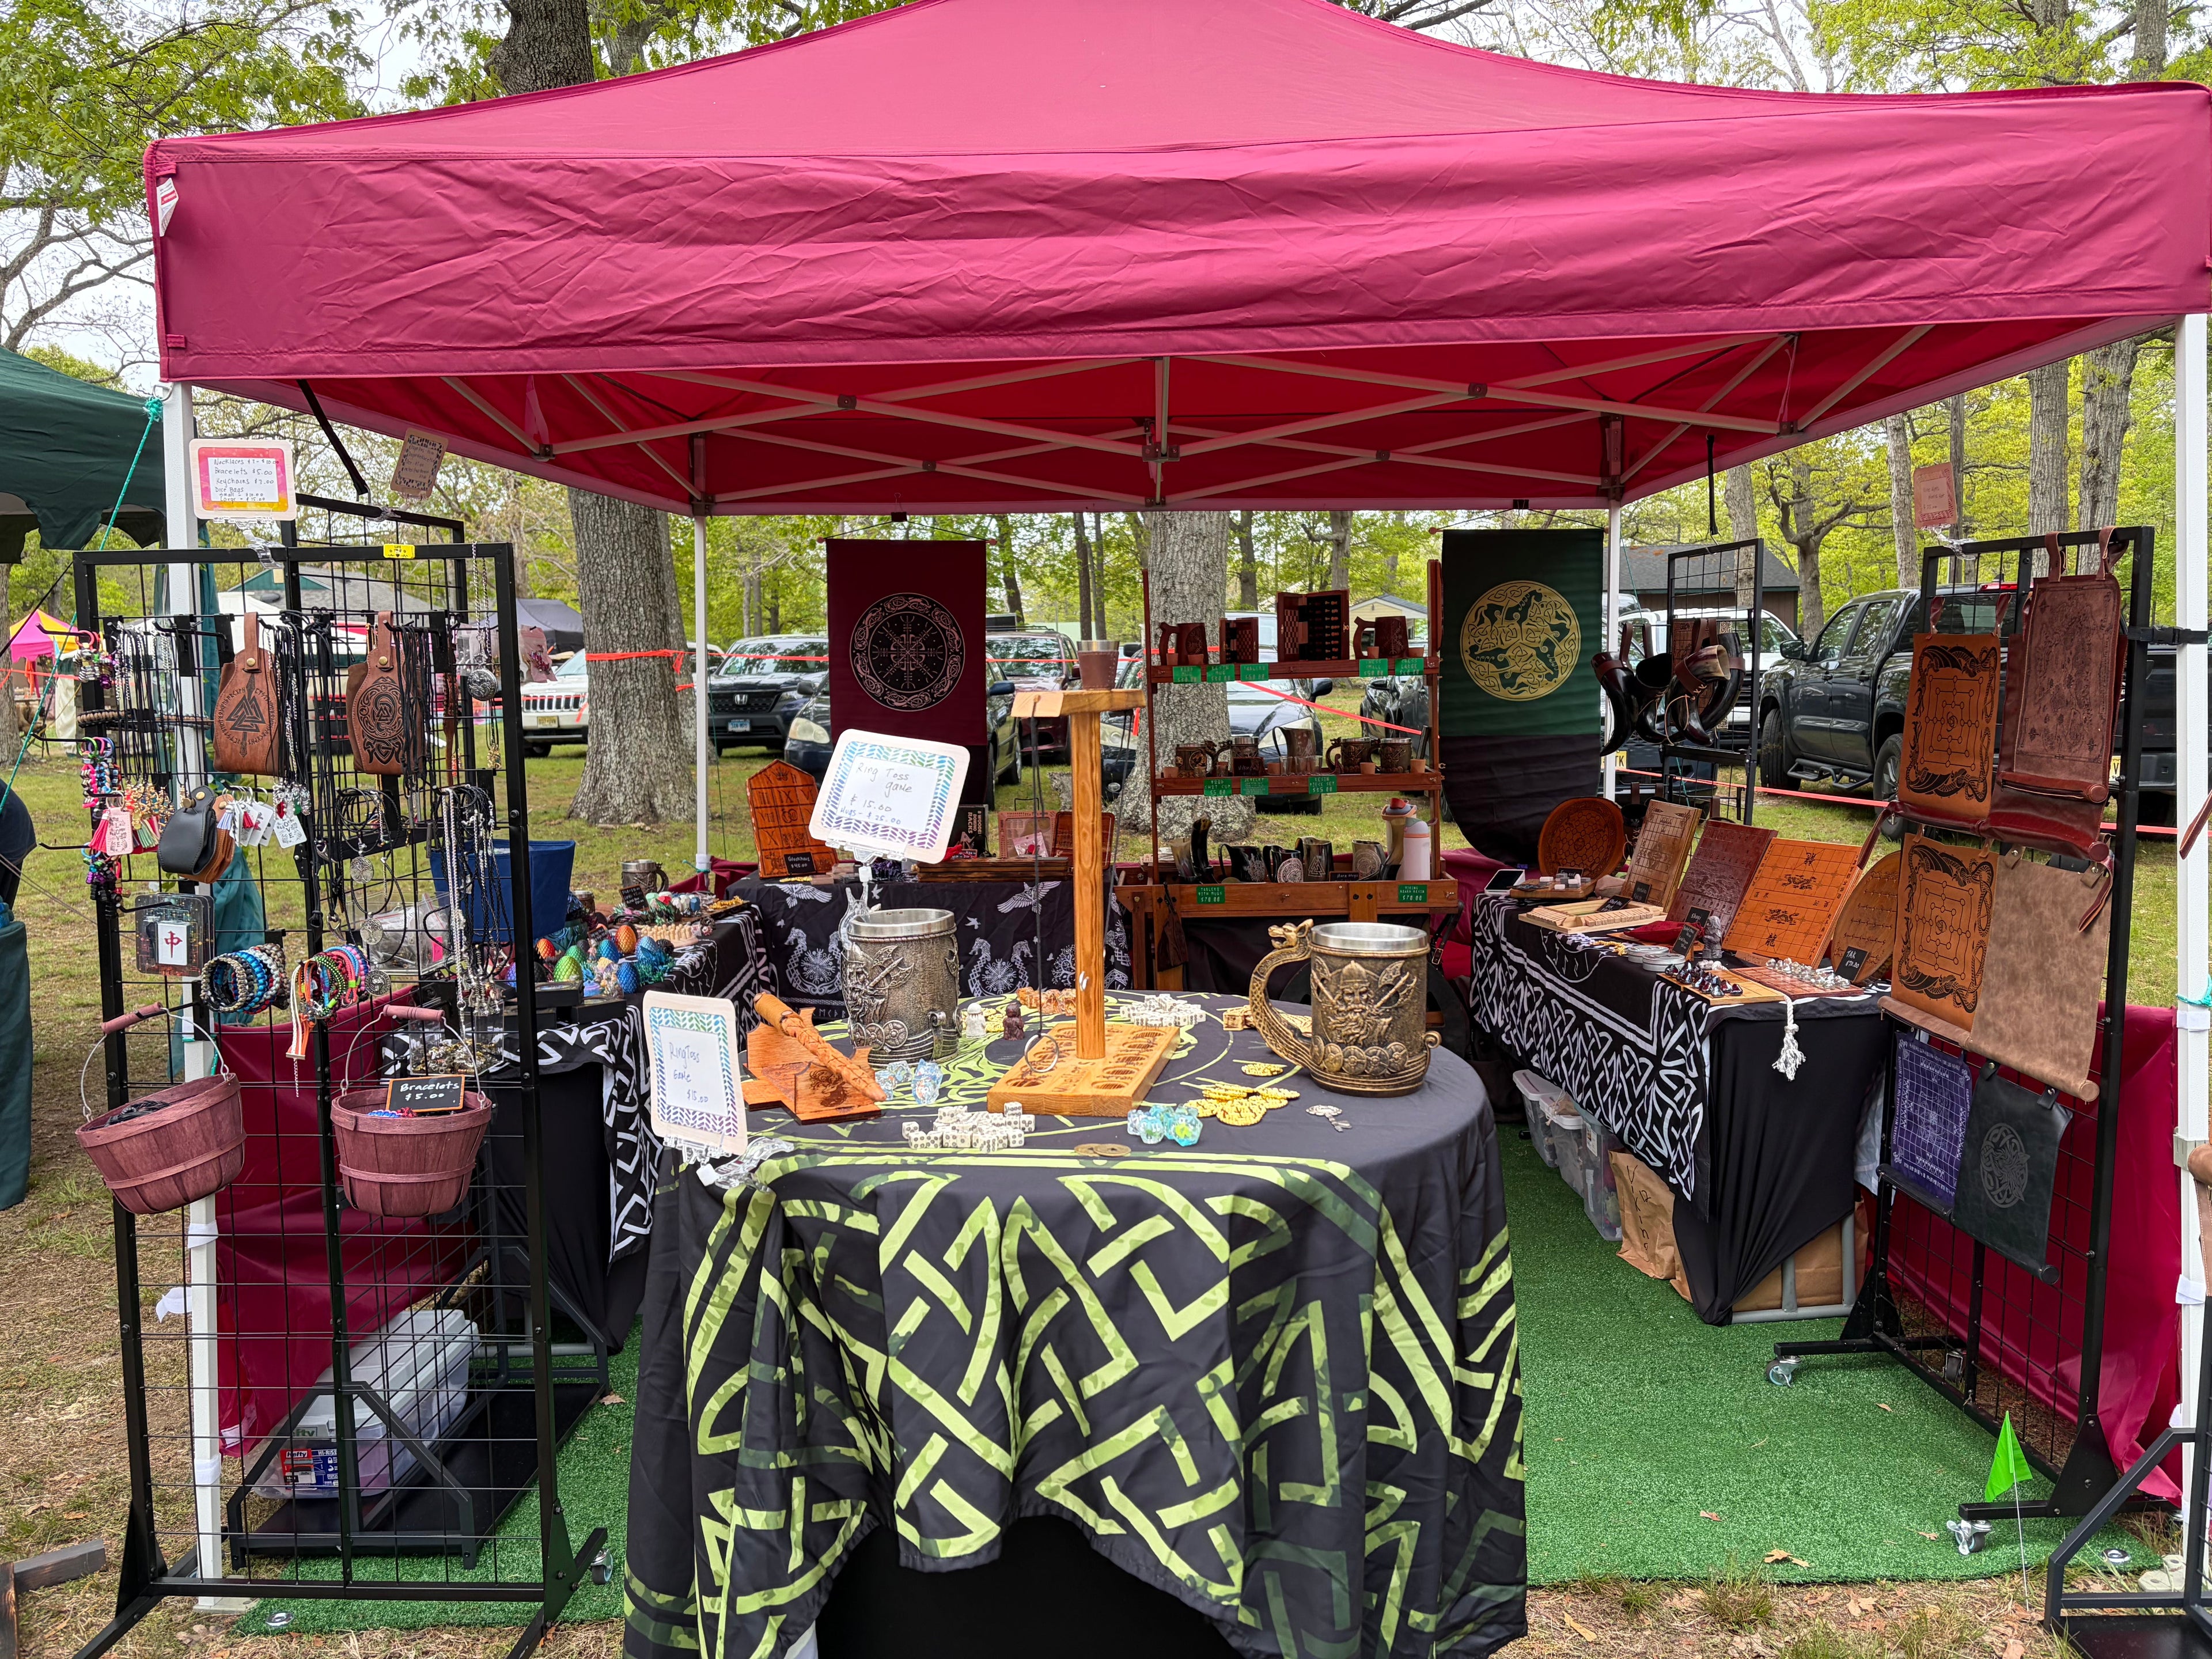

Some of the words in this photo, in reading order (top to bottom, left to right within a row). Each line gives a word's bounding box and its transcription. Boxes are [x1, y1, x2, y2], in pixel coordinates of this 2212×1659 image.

[856, 762, 878, 782] Ring
[886, 768, 910, 781] Toss
[164, 930, 183, 959] 中
[1846, 950, 1857, 959] TAK
[400, 1081, 460, 1092] Bracelets
[405, 1093, 445, 1101] $5.00
[687, 1089, 709, 1103] $15.00
